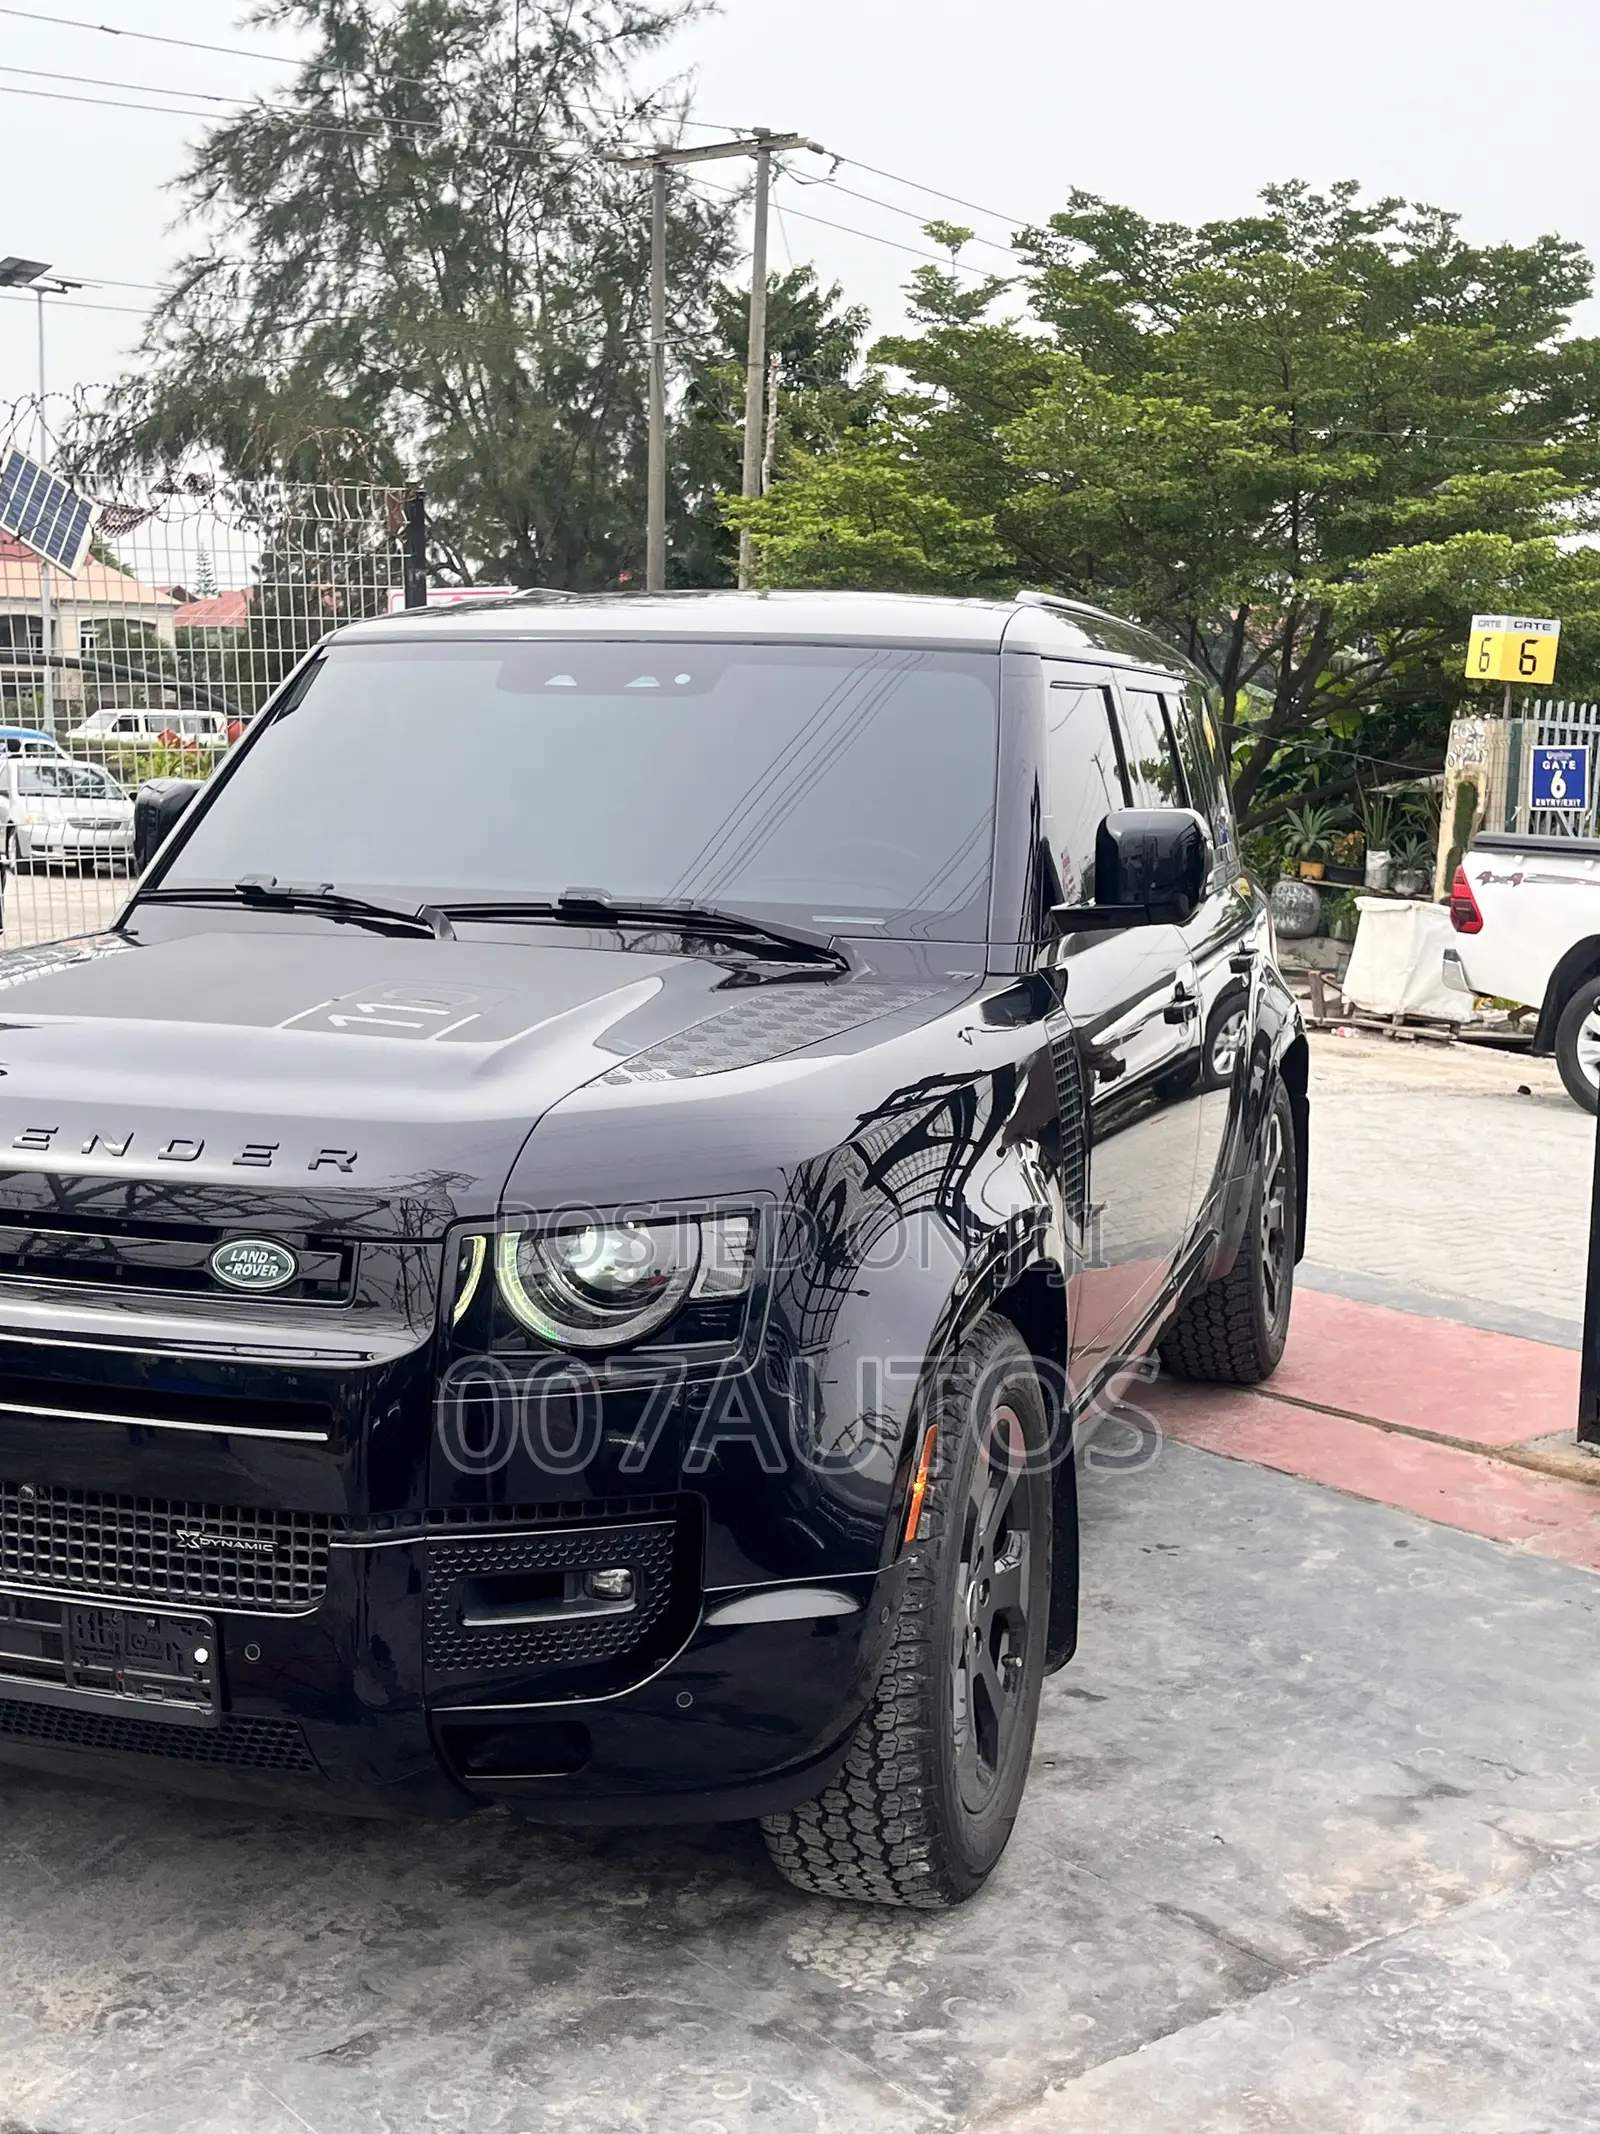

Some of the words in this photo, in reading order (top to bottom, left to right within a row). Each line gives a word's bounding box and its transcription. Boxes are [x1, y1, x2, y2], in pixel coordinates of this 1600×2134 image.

[1477, 619, 1502, 629] GATE
[1513, 621, 1552, 632] GATE
[1479, 637, 1492, 672] 6
[1518, 639, 1539, 676] 6
[1542, 760, 1576, 770] GATE
[1551, 769, 1567, 799] 6
